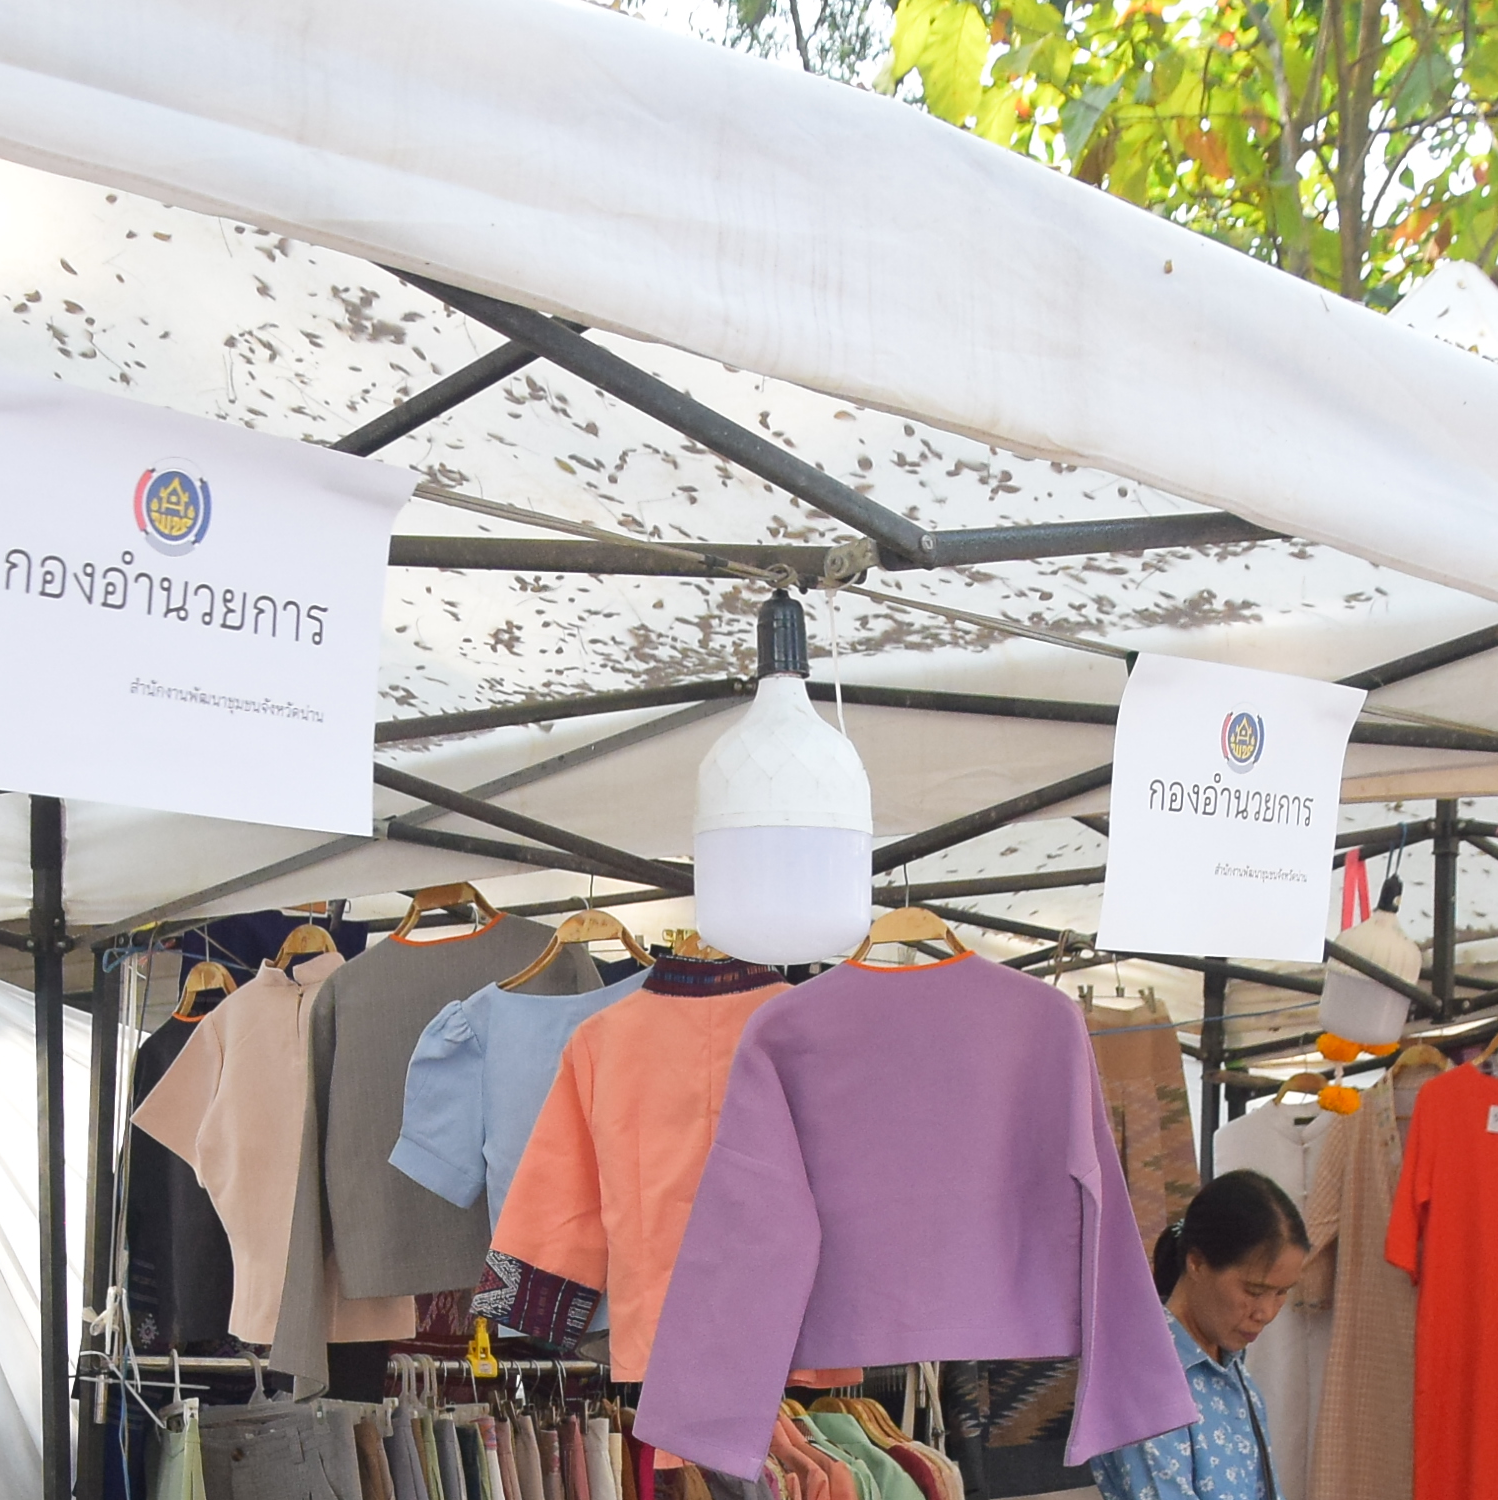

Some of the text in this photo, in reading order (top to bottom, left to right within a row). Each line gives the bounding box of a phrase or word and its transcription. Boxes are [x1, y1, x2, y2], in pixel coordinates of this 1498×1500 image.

[4, 548, 329, 646] กองอำนวยการ
[129, 677, 325, 724] สำนักงานพัฒนาชุมชนจังหวัดน่าน
[1149, 772, 1314, 827] กองอำนวยการ
